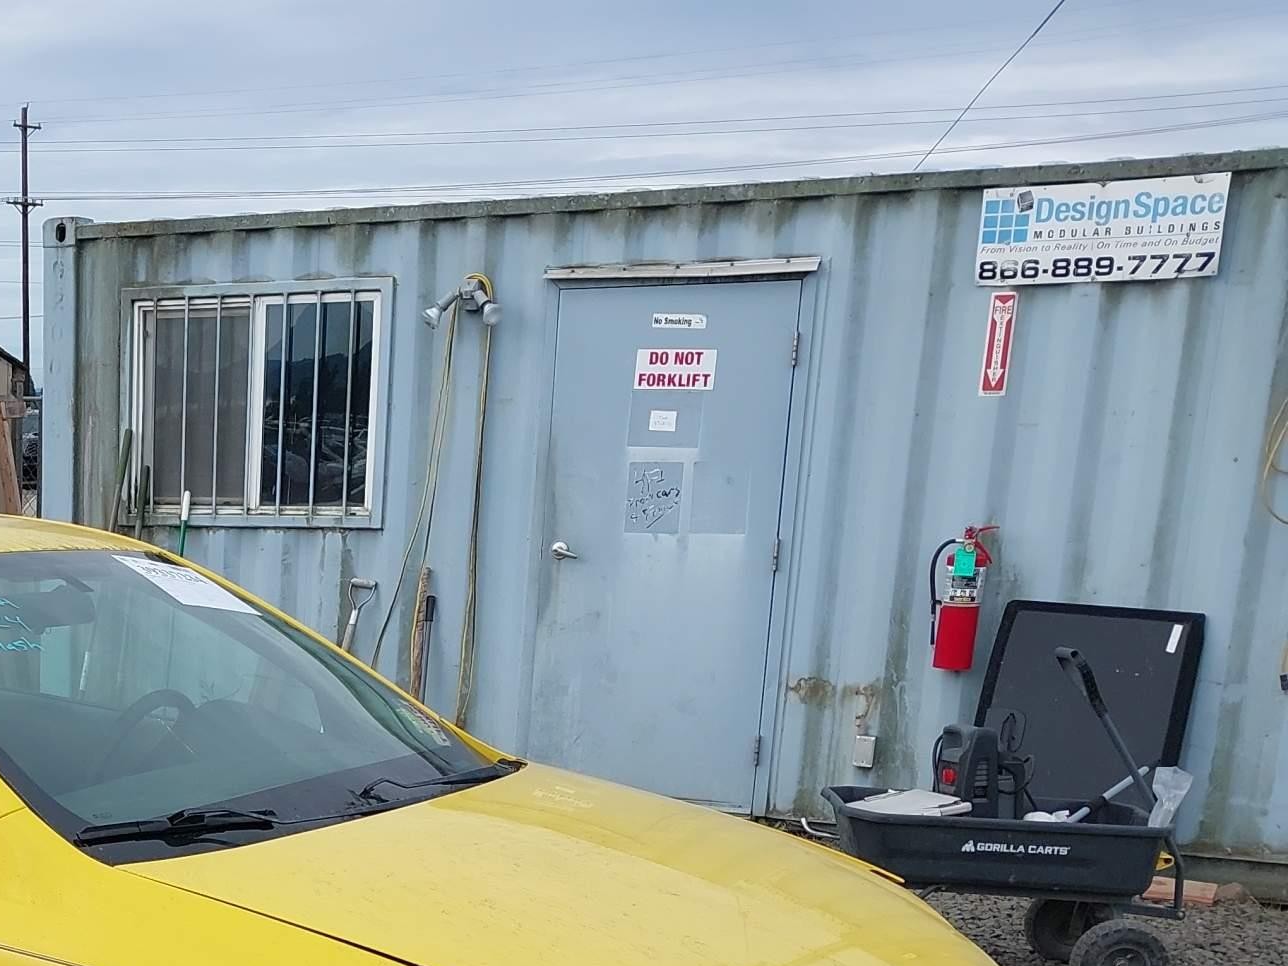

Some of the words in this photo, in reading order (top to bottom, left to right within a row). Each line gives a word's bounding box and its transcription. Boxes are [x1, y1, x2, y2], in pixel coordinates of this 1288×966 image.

[1035, 191, 1225, 226] DesignSpace
[980, 246, 1006, 255] From
[1008, 244, 1038, 253] Vision
[1041, 244, 1051, 252] to
[1053, 241, 1089, 251] Reality
[1096, 240, 1111, 249] On
[1114, 239, 1138, 249] Time
[1140, 239, 1161, 248] and
[1163, 238, 1178, 247] On
[1180, 236, 1220, 247] Budget
[978, 251, 1217, 281] 866-889-7777
[994, 305, 1013, 315] FIRE
[653, 316, 663, 325] No
[663, 316, 693, 327] Smoking
[648, 351, 669, 365] DO
[674, 351, 704, 365] NOT
[637, 373, 712, 387] FORKLIFT
[976, 842, 1025, 853] GORILLA
[1027, 845, 1069, 856] CARTS
